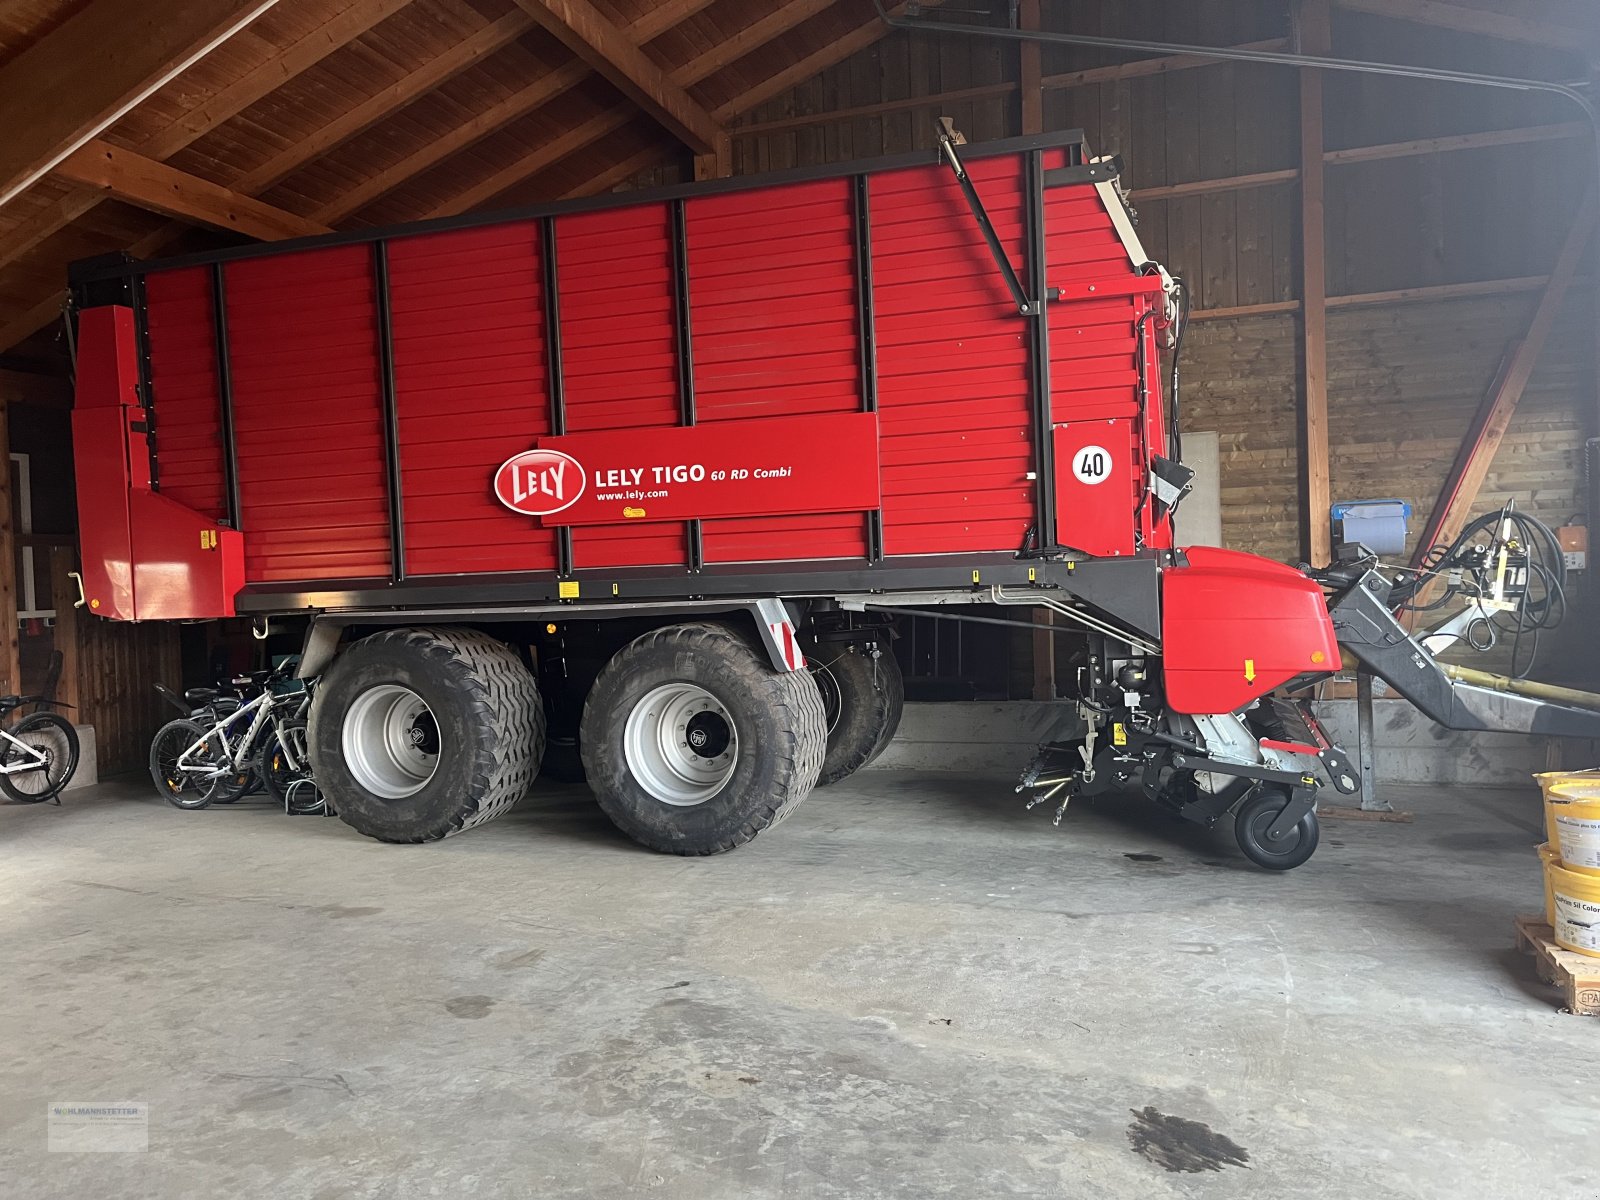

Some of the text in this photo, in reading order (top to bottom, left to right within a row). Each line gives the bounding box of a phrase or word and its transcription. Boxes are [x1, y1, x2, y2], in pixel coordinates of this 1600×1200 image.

[595, 464, 792, 488] LELY TIGO 60 RD Combi
[1081, 453, 1104, 477] 40
[512, 460, 565, 505] LELY
[597, 489, 669, 501] www.lely.com
[1573, 901, 1581, 909] Sil
[1582, 904, 1600, 913] Color
